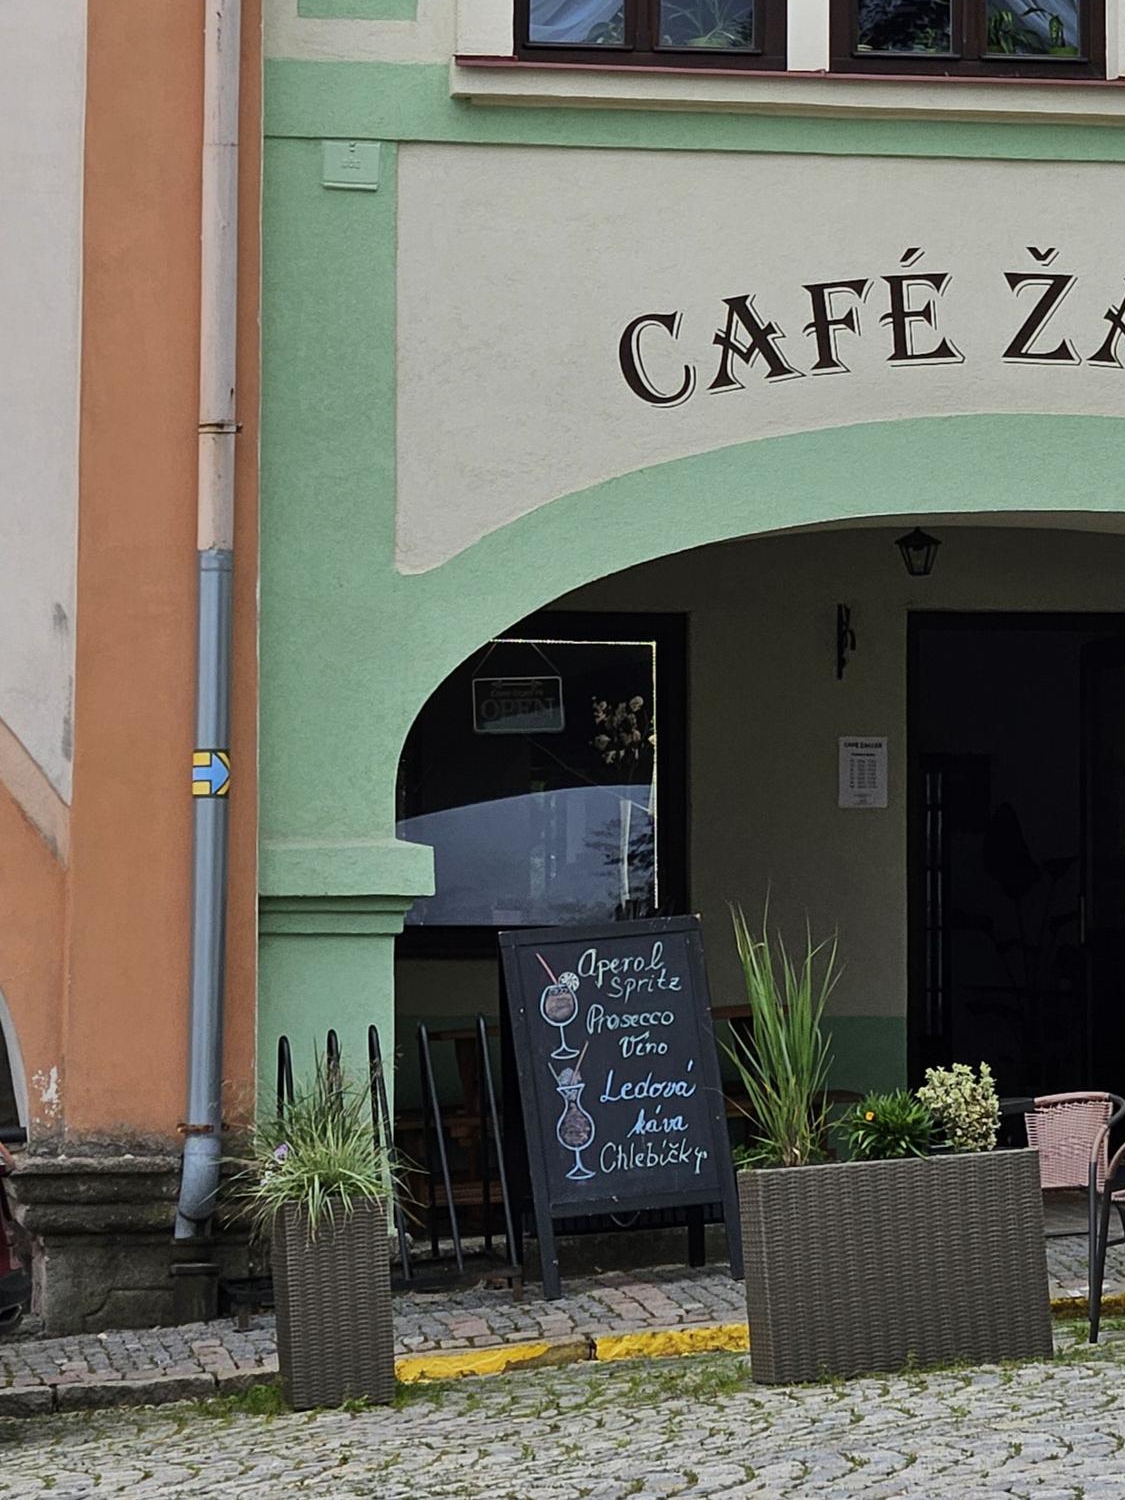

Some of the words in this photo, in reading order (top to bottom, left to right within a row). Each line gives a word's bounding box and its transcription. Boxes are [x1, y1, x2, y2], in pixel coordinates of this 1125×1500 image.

[618, 246, 966, 409] CAFÉ
[578, 941, 665, 988] Aperol
[607, 967, 682, 1003] Spritz
[586, 1003, 674, 1035] Prosecco
[600, 1059, 696, 1103] Ledová
[627, 1104, 688, 1138] káva
[600, 1138, 708, 1175] Chlebíčky
